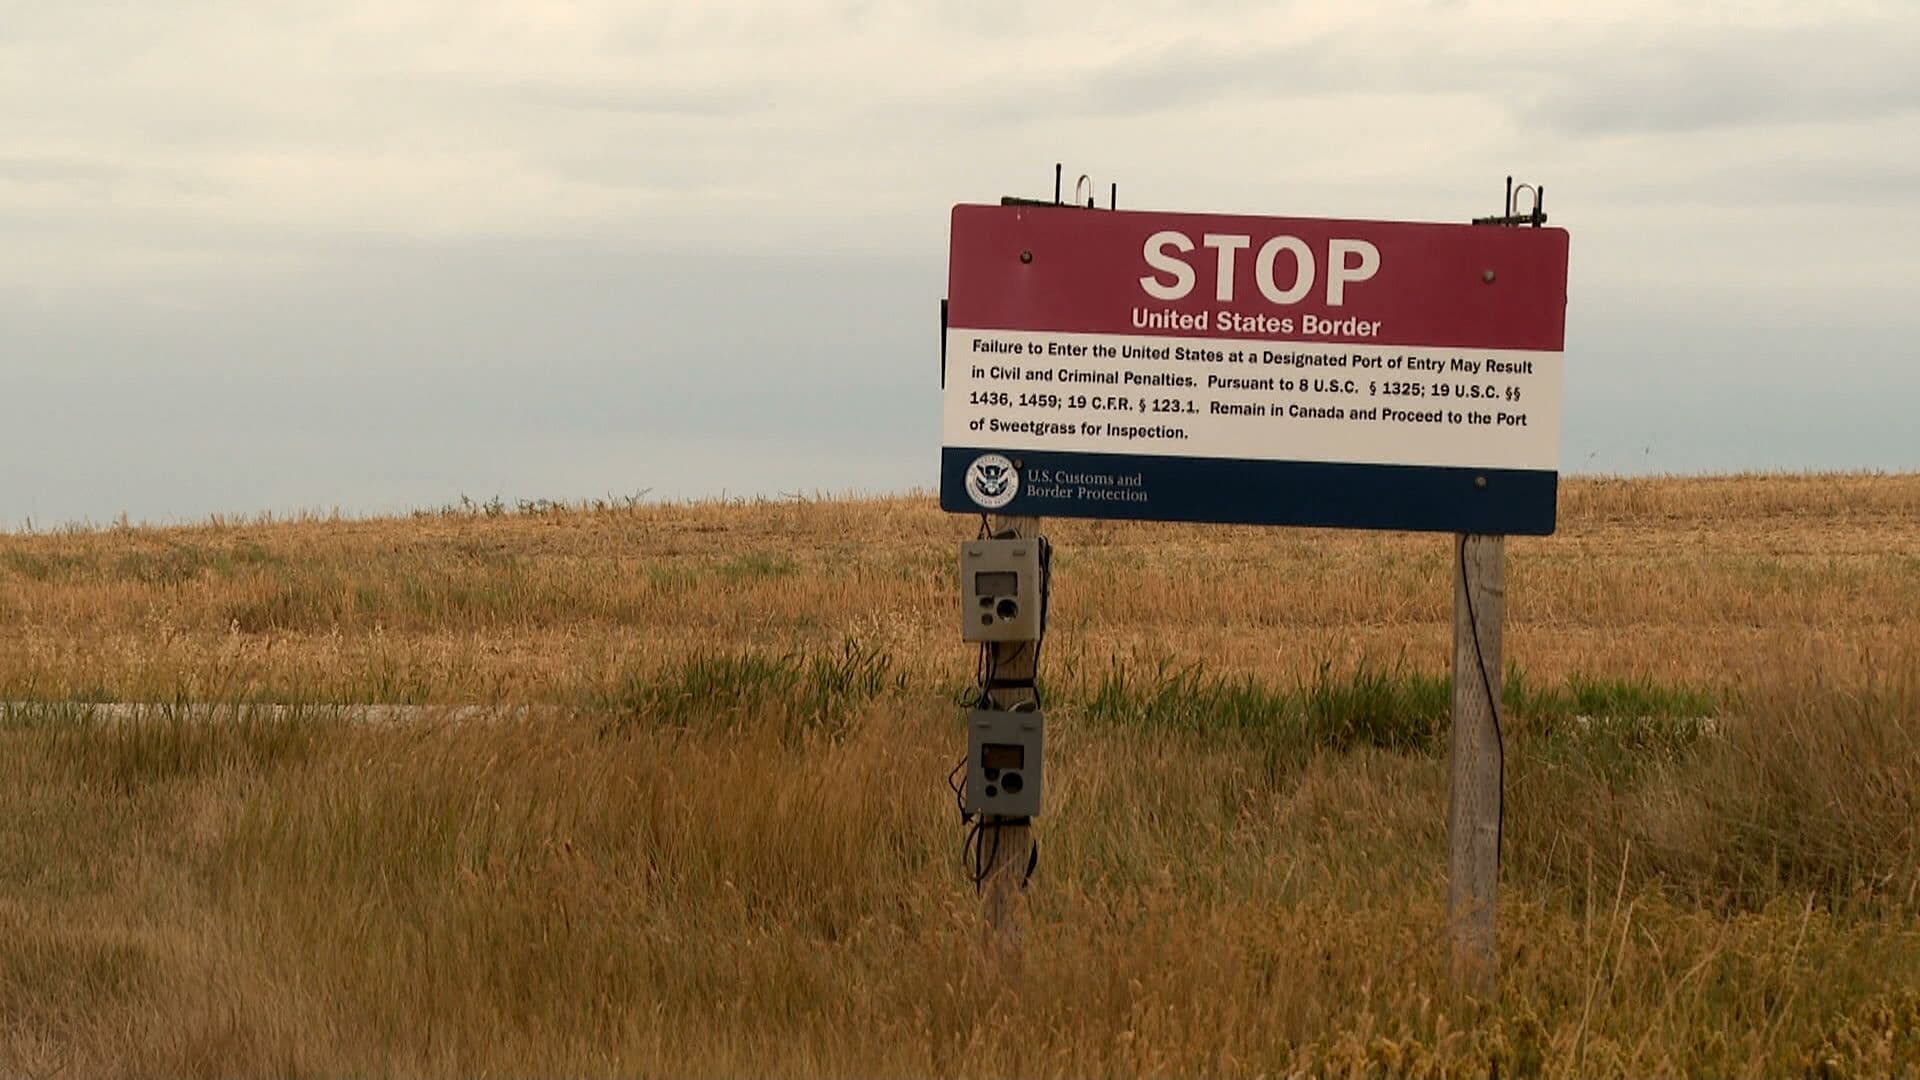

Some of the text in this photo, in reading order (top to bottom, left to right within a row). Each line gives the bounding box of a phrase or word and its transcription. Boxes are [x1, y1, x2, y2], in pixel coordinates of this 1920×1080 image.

[1139, 231, 1381, 306] STOP
[1132, 308, 1382, 337] United States Border
[972, 338, 1533, 376] Failure to Enter the United States at a Designated Port of Entry May Result
[971, 364, 1521, 403] in Civil and Criminal Penalties. Pursuant to 8 U.S.C. § 1325; 19 U.S.C. §§
[969, 390, 1528, 427] 1436, 1459; 19 C.F.R. § 123.1. Remain in Canada and Proceed to the Port
[969, 416, 1189, 441] of Sweetgrass for Inspection.
[1027, 469, 1143, 487] U.S. Customs and
[1027, 484, 1149, 502] Border Protection
